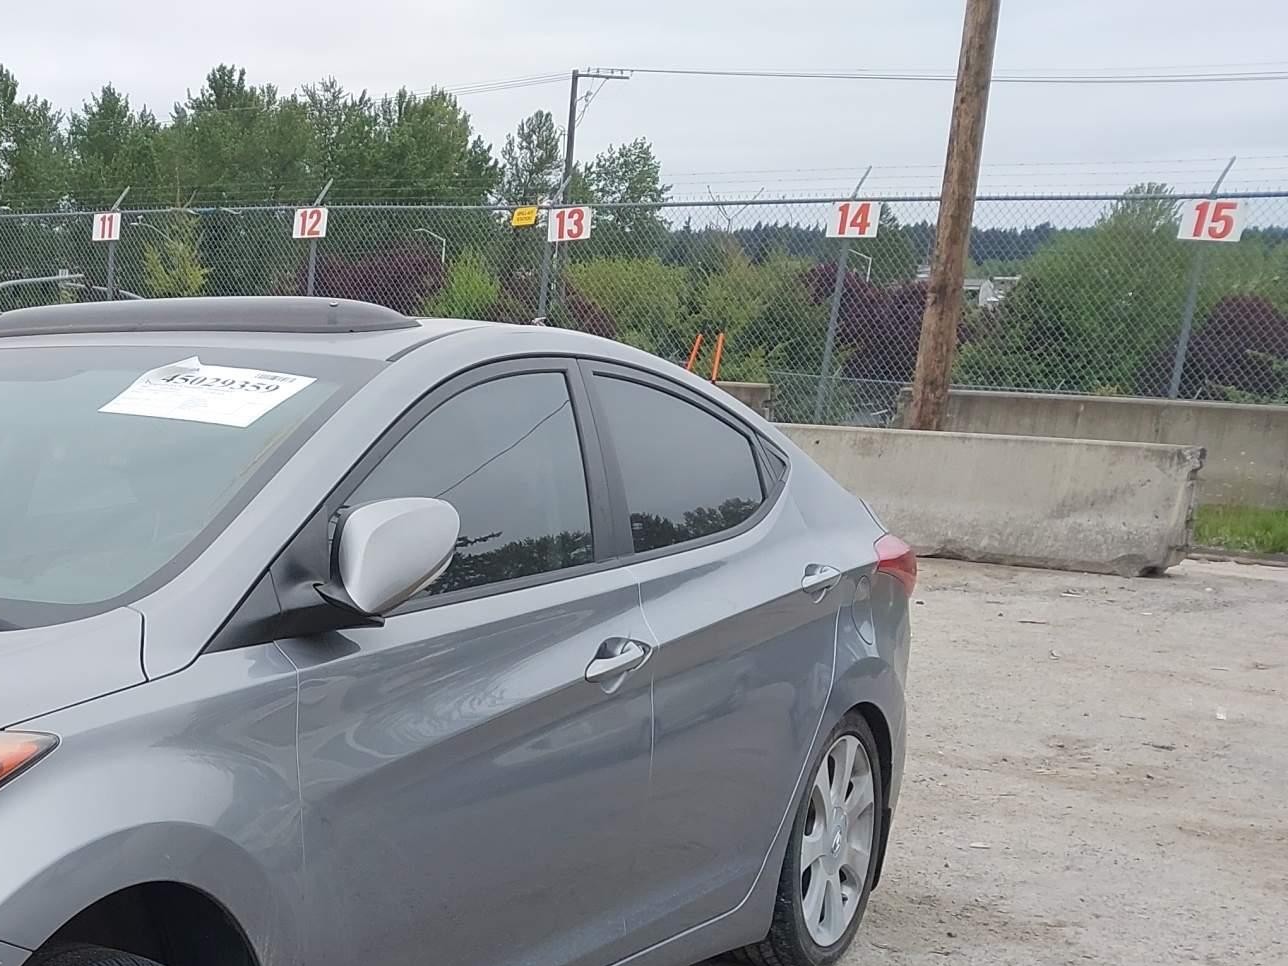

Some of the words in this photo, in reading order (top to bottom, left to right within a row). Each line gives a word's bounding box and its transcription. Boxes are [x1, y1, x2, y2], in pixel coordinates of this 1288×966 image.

[100, 214, 114, 239] 11
[300, 209, 320, 236] 12
[556, 208, 584, 239] 13
[838, 203, 871, 235] 14
[1193, 201, 1238, 239] 15
[161, 373, 280, 394] 45029359
